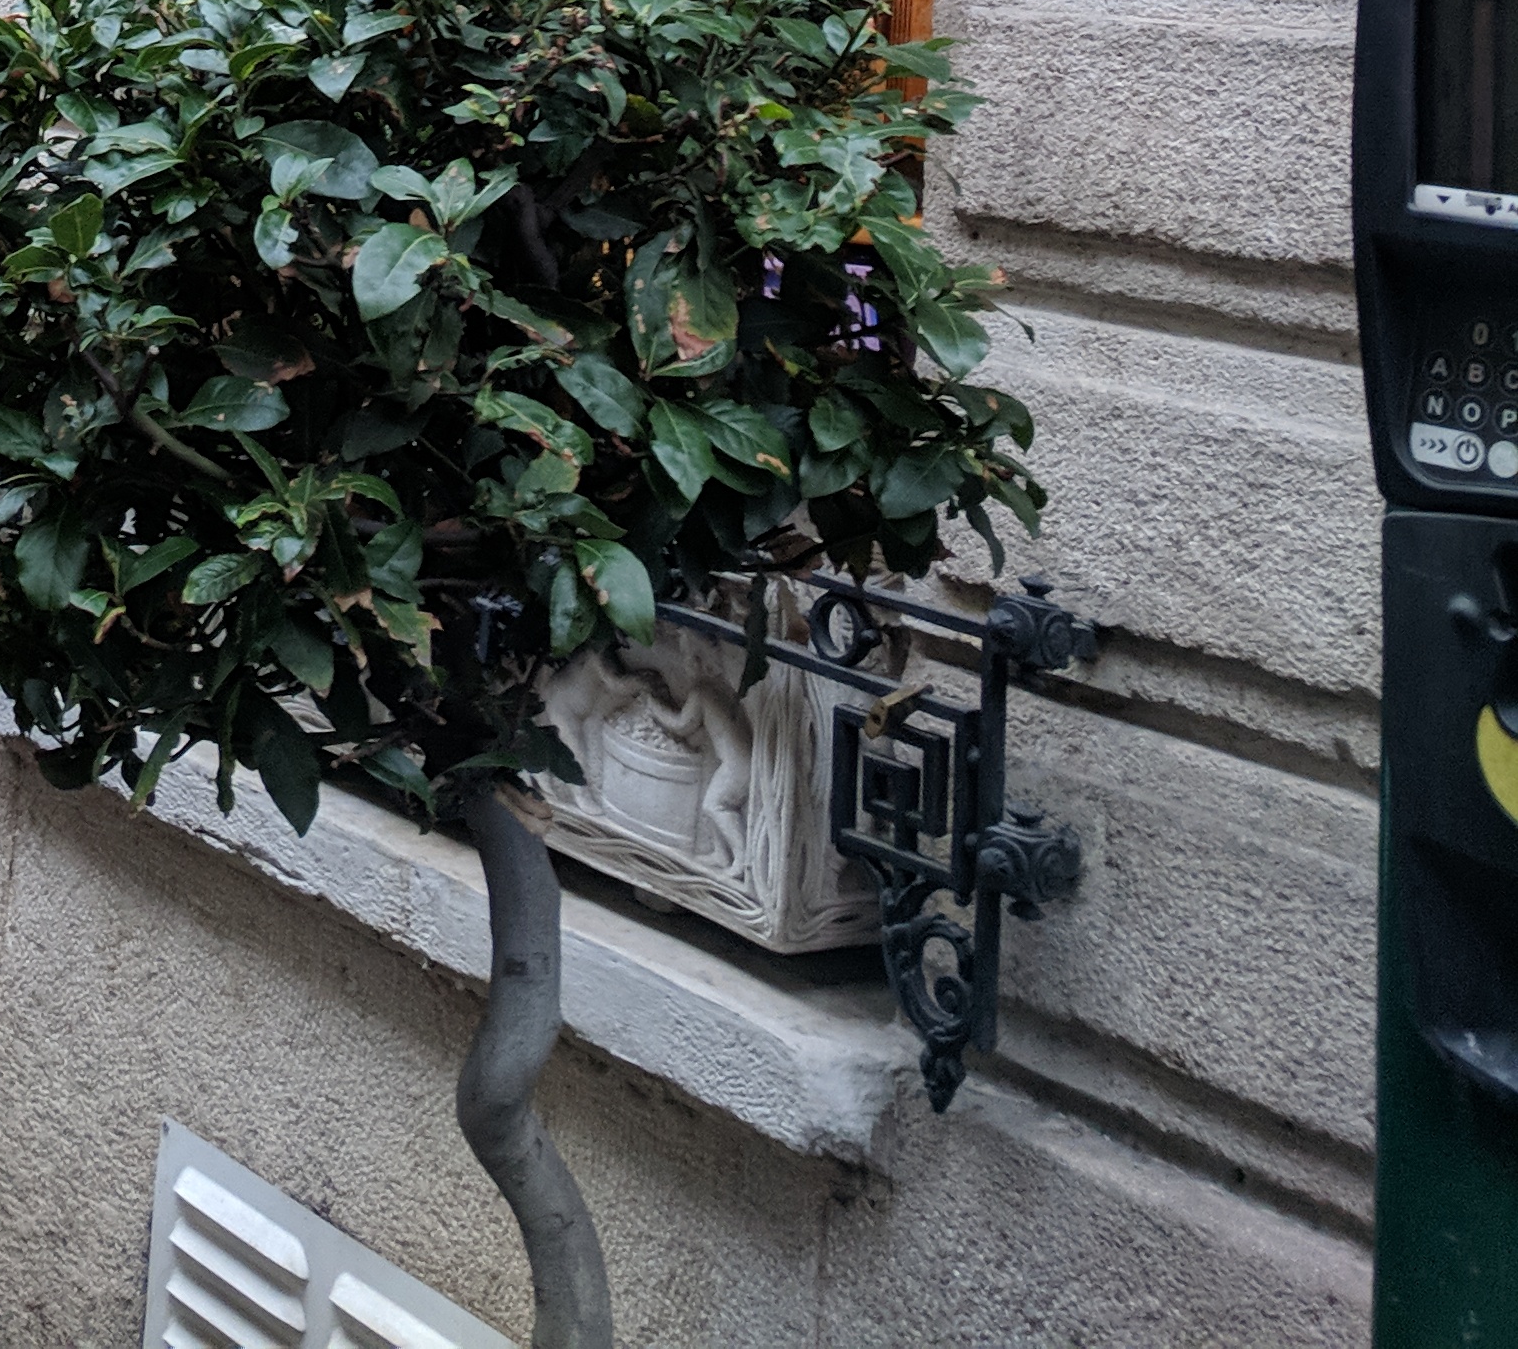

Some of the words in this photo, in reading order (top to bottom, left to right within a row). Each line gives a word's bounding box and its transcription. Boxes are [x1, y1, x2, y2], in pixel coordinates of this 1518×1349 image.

[1430, 357, 1449, 378] A
[1468, 363, 1485, 383] B
[1427, 395, 1444, 416] N
